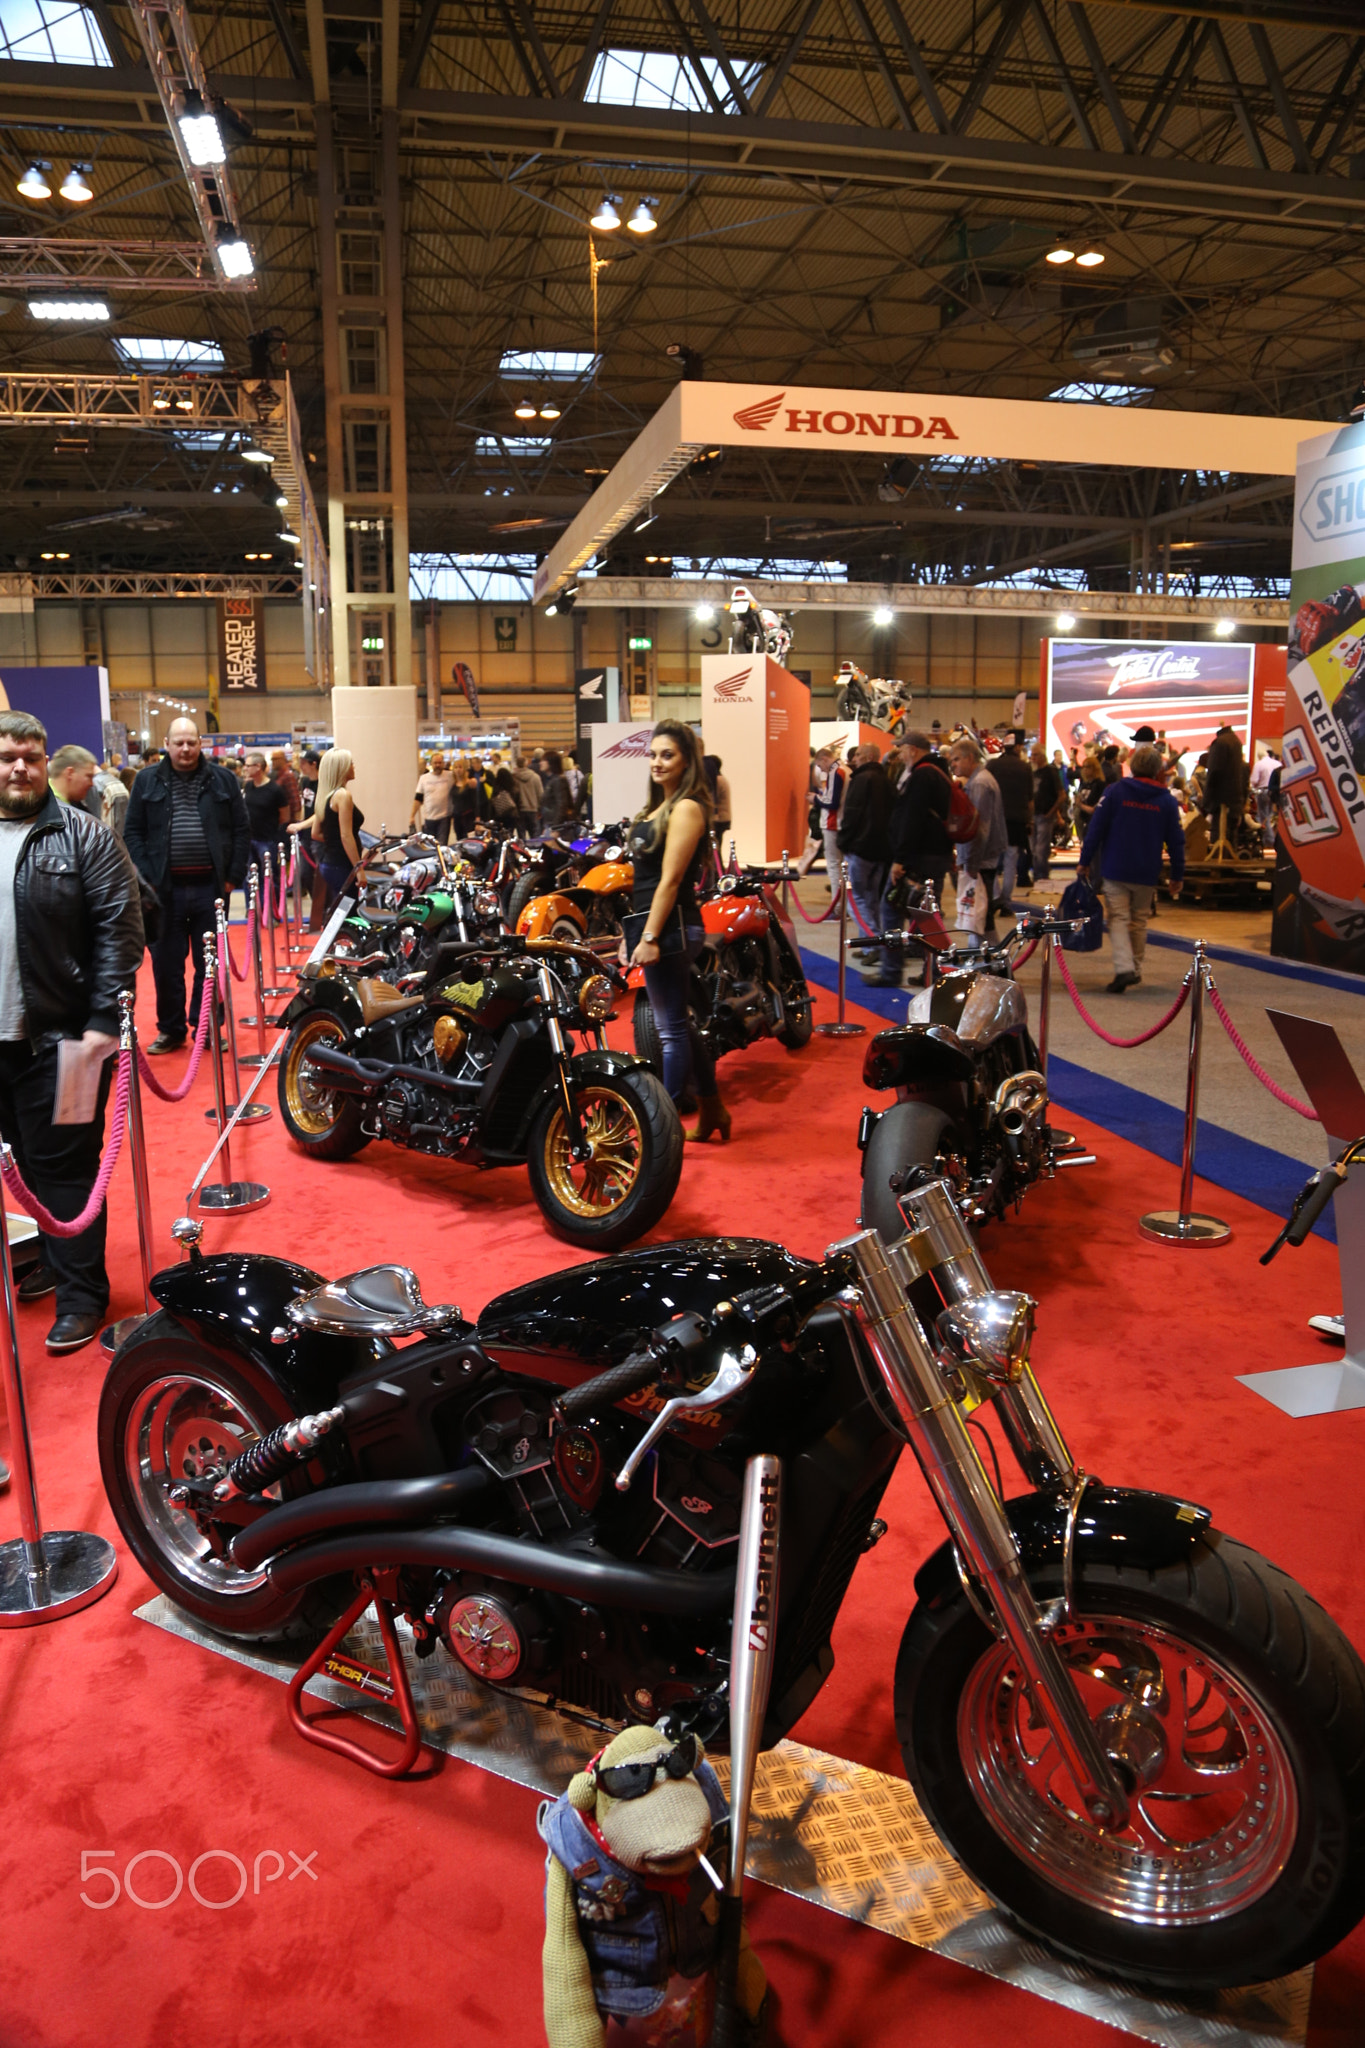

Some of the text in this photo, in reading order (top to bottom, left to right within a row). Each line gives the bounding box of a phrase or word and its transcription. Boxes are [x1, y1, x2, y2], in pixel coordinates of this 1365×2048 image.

[785, 409, 959, 440] HONDA
[225, 620, 244, 688] HEATED
[241, 620, 258, 688] APPAREL
[1106, 651, 1201, 696] Total Control
[713, 696, 754, 704] HONDA
[1303, 690, 1365, 824] REPSOL
[1122, 800, 1161, 812] HONDA
[751, 1473, 779, 1621] barnett
[328, 1660, 363, 1682] THOR
